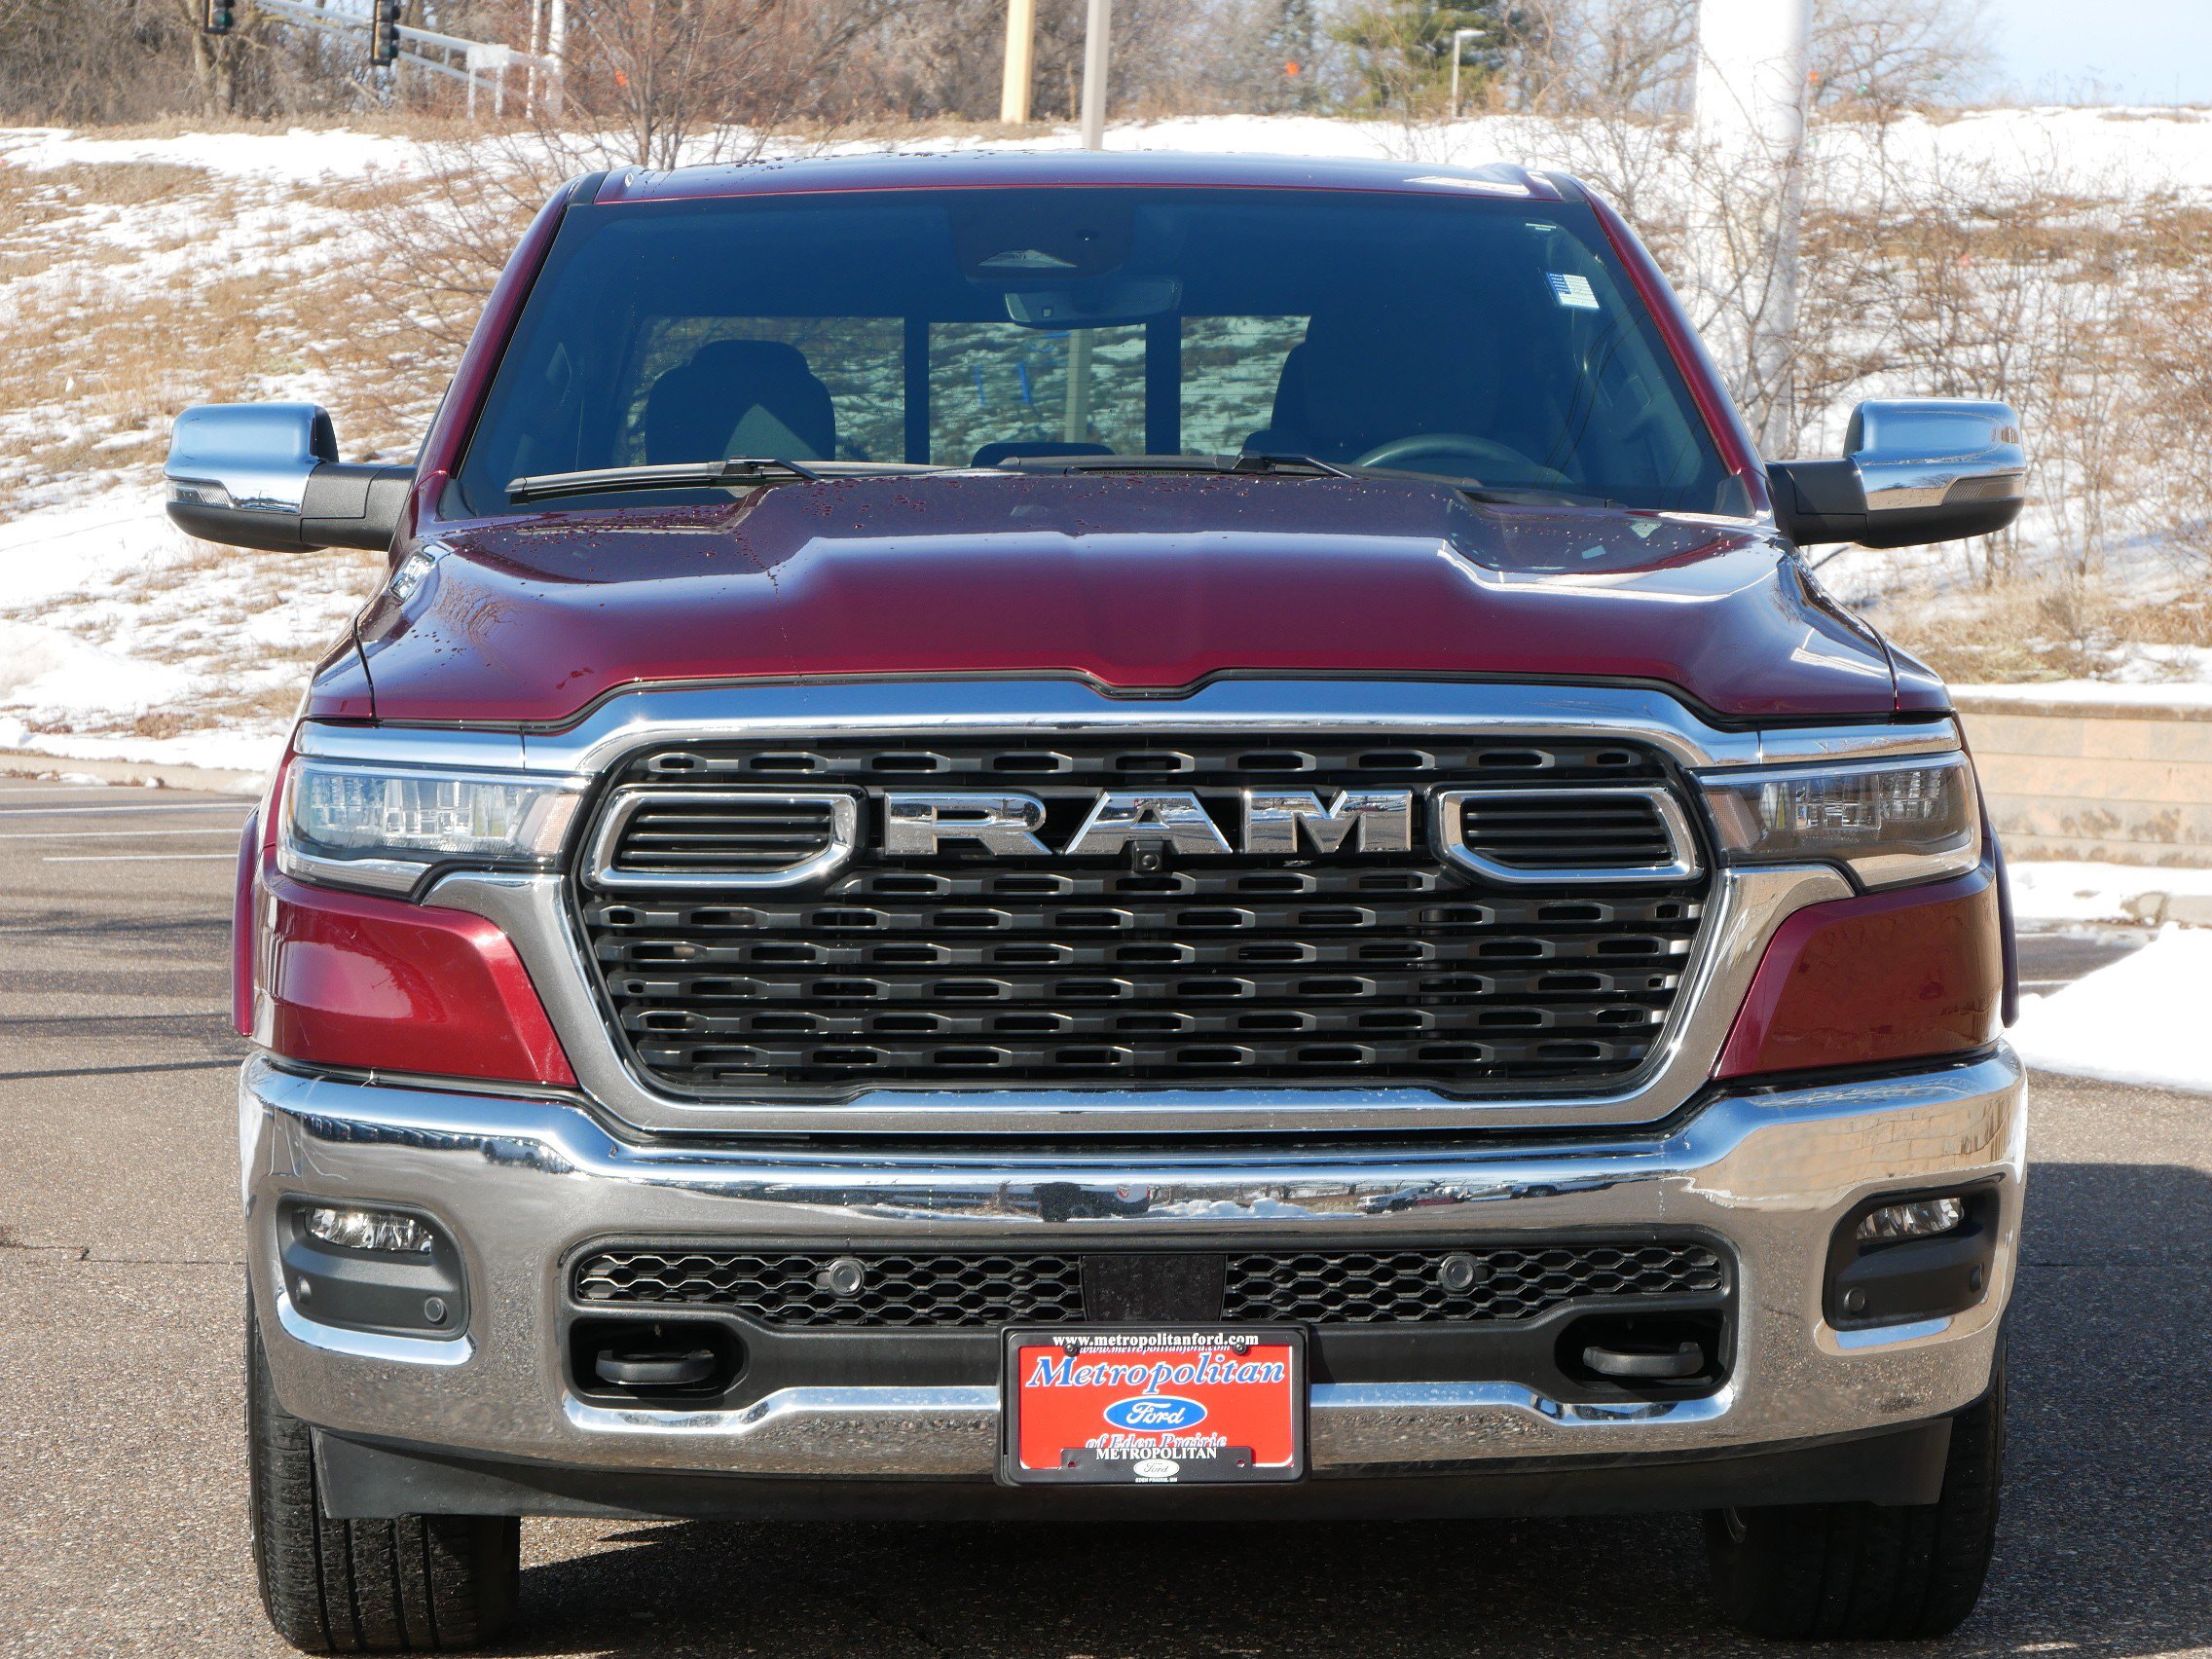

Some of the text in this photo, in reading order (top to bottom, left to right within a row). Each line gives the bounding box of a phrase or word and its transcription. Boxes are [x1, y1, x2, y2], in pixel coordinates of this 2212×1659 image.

[884, 791, 1413, 855] RAM
[1052, 1333, 1259, 1347] www.metropolitanford.com
[1025, 1352, 1285, 1394] Metropolitan
[1126, 1402, 1185, 1424] Ford
[1108, 1433, 1157, 1448] Eden
[1159, 1432, 1228, 1448] Prairie
[1096, 1448, 1217, 1459] METROPOLITAN
[1143, 1462, 1169, 1473] Ford
